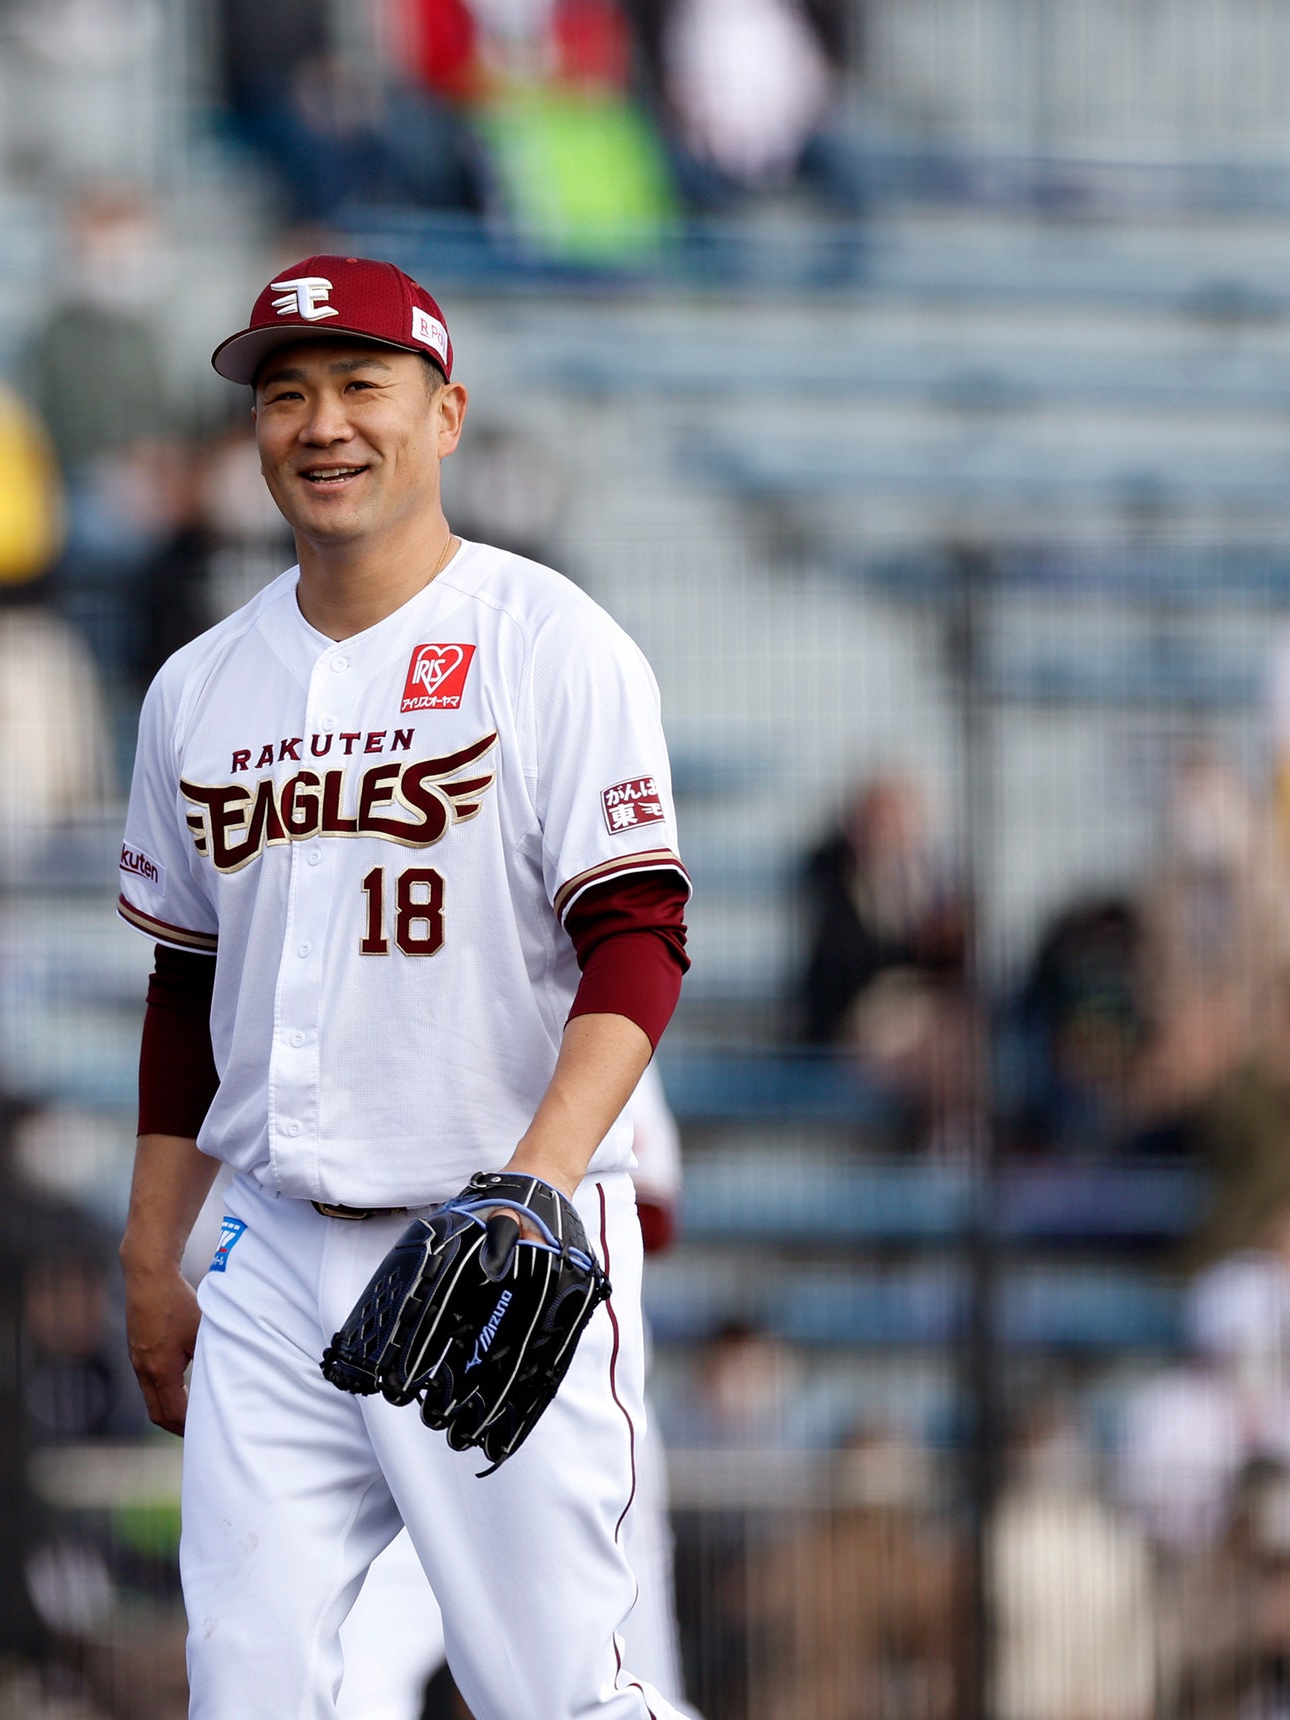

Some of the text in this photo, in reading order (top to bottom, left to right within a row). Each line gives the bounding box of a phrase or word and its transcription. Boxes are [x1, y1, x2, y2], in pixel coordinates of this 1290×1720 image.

[412, 659, 447, 684] IRIS
[401, 695, 461, 711] アイリスオーヤマ
[230, 728, 416, 774] RAKUTEN
[180, 730, 499, 874] EAGLES
[120, 843, 158, 884] kuten
[360, 865, 446, 957] 18
[479, 1289, 513, 1353] MIZUNO
